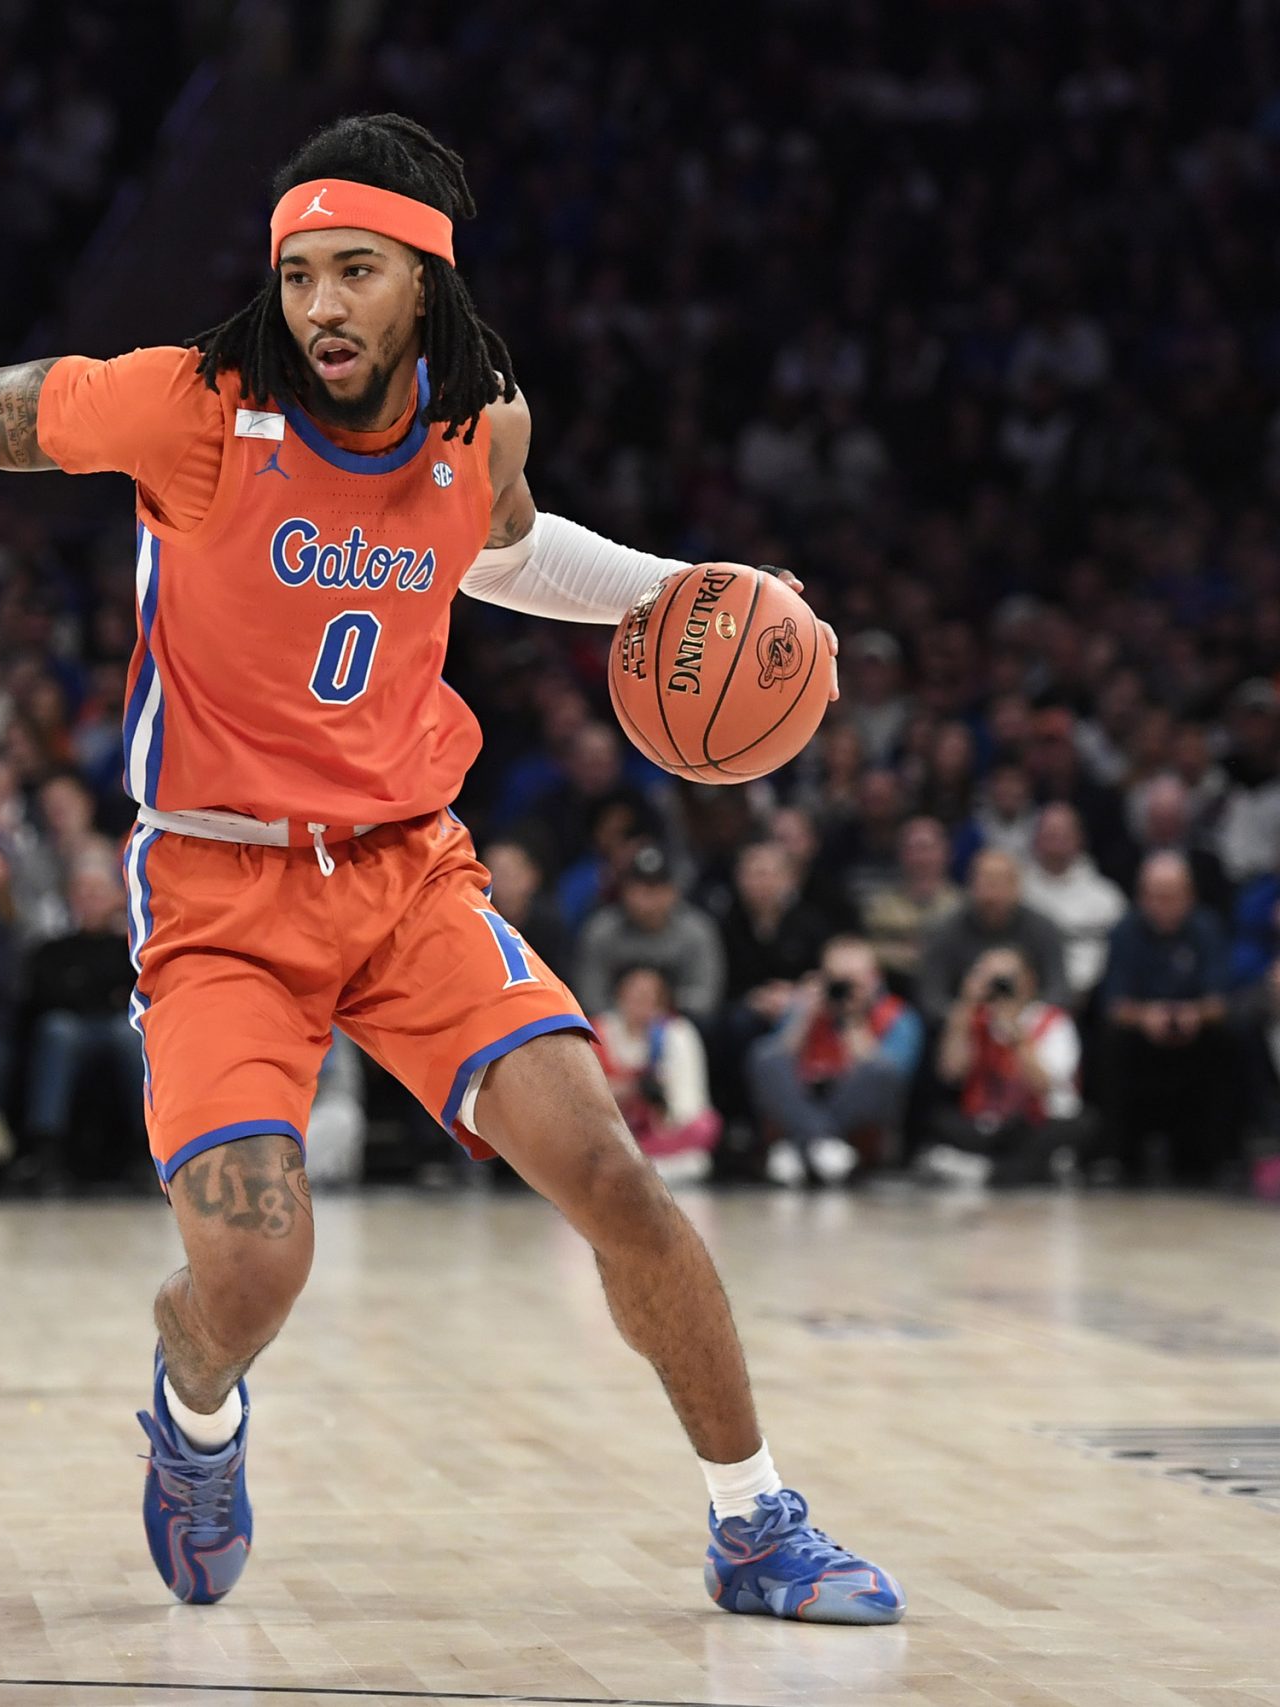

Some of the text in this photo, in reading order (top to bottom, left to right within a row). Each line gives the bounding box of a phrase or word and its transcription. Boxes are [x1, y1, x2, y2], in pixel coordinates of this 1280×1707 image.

[432, 462, 453, 487] SEC
[270, 518, 436, 591] Gators
[308, 610, 382, 705] 0
[668, 568, 737, 696] SPALDING
